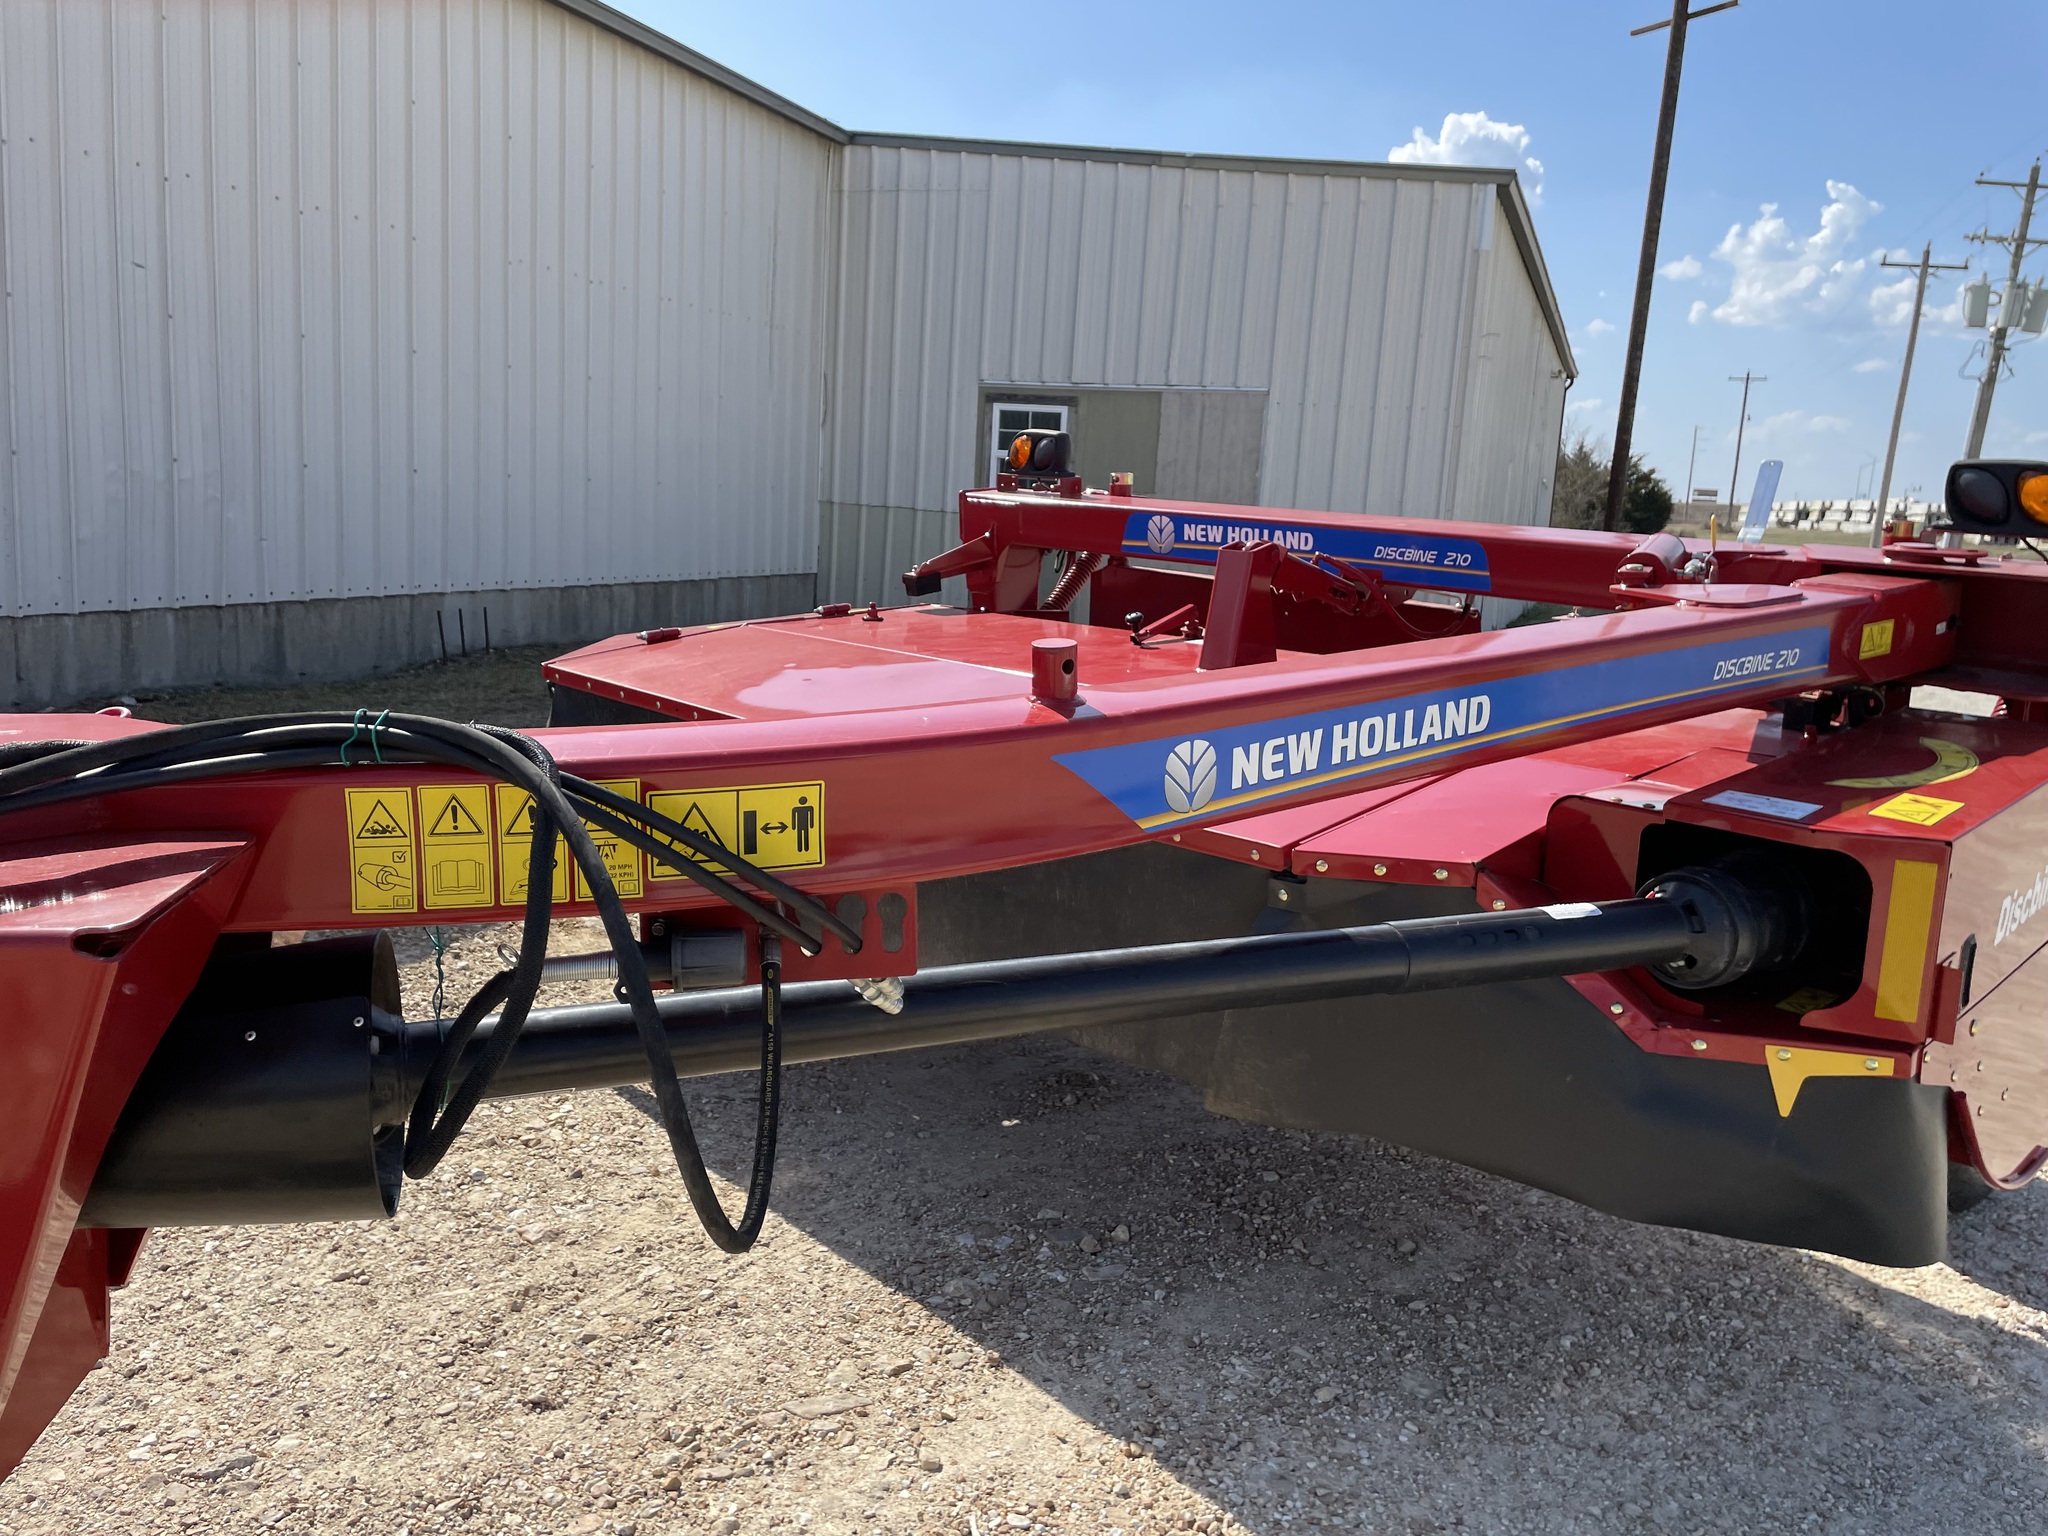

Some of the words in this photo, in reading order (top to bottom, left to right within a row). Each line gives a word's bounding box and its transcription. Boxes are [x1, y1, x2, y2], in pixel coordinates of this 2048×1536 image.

[1183, 523, 1223, 543] NEW
[1227, 526, 1314, 551] HOLLAND
[1374, 545, 1438, 564] DISCBINE
[1443, 552, 1472, 567] 210
[1713, 652, 1775, 681] DISCBINE
[1775, 648, 1801, 670] 210
[1231, 728, 1323, 790] NEW
[1331, 695, 1491, 765] HOLLAND
[764, 1052, 774, 1103] WEARGUARD
